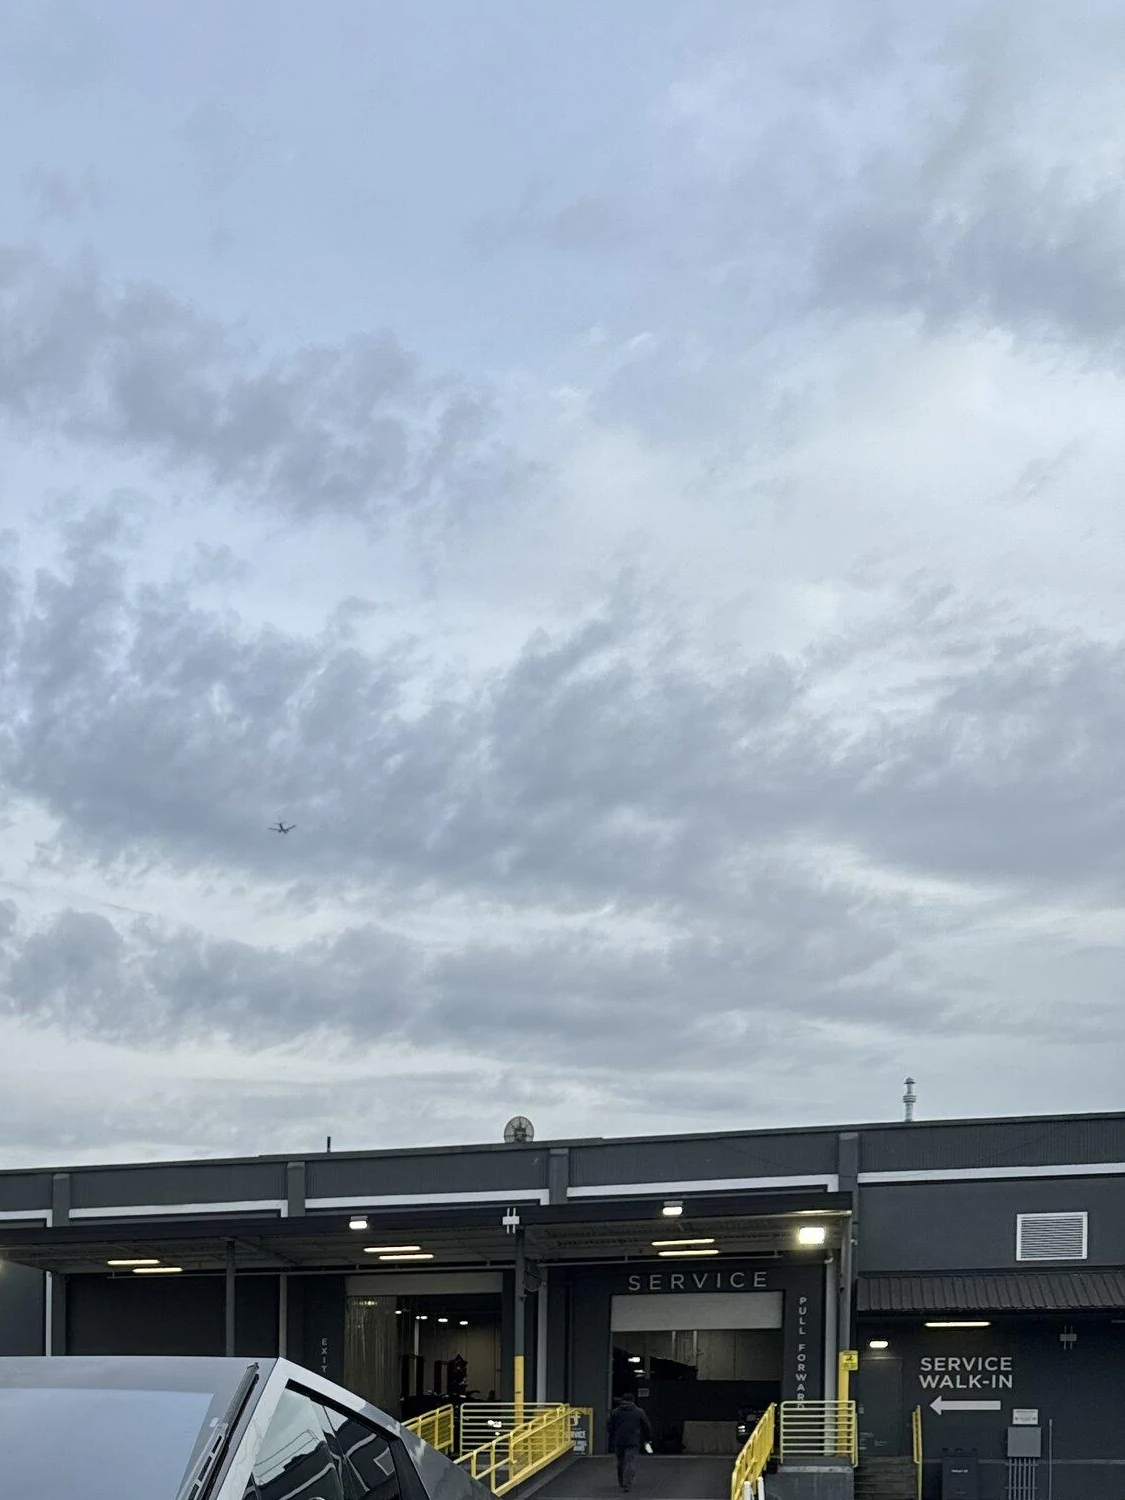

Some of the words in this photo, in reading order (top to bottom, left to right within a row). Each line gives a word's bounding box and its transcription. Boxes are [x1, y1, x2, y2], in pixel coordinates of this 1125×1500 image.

[628, 1271, 768, 1291] SERVICE
[798, 1296, 808, 1335] PULL
[920, 1356, 1013, 1372] SERVICE
[918, 1374, 1013, 1389] WALK-IN
